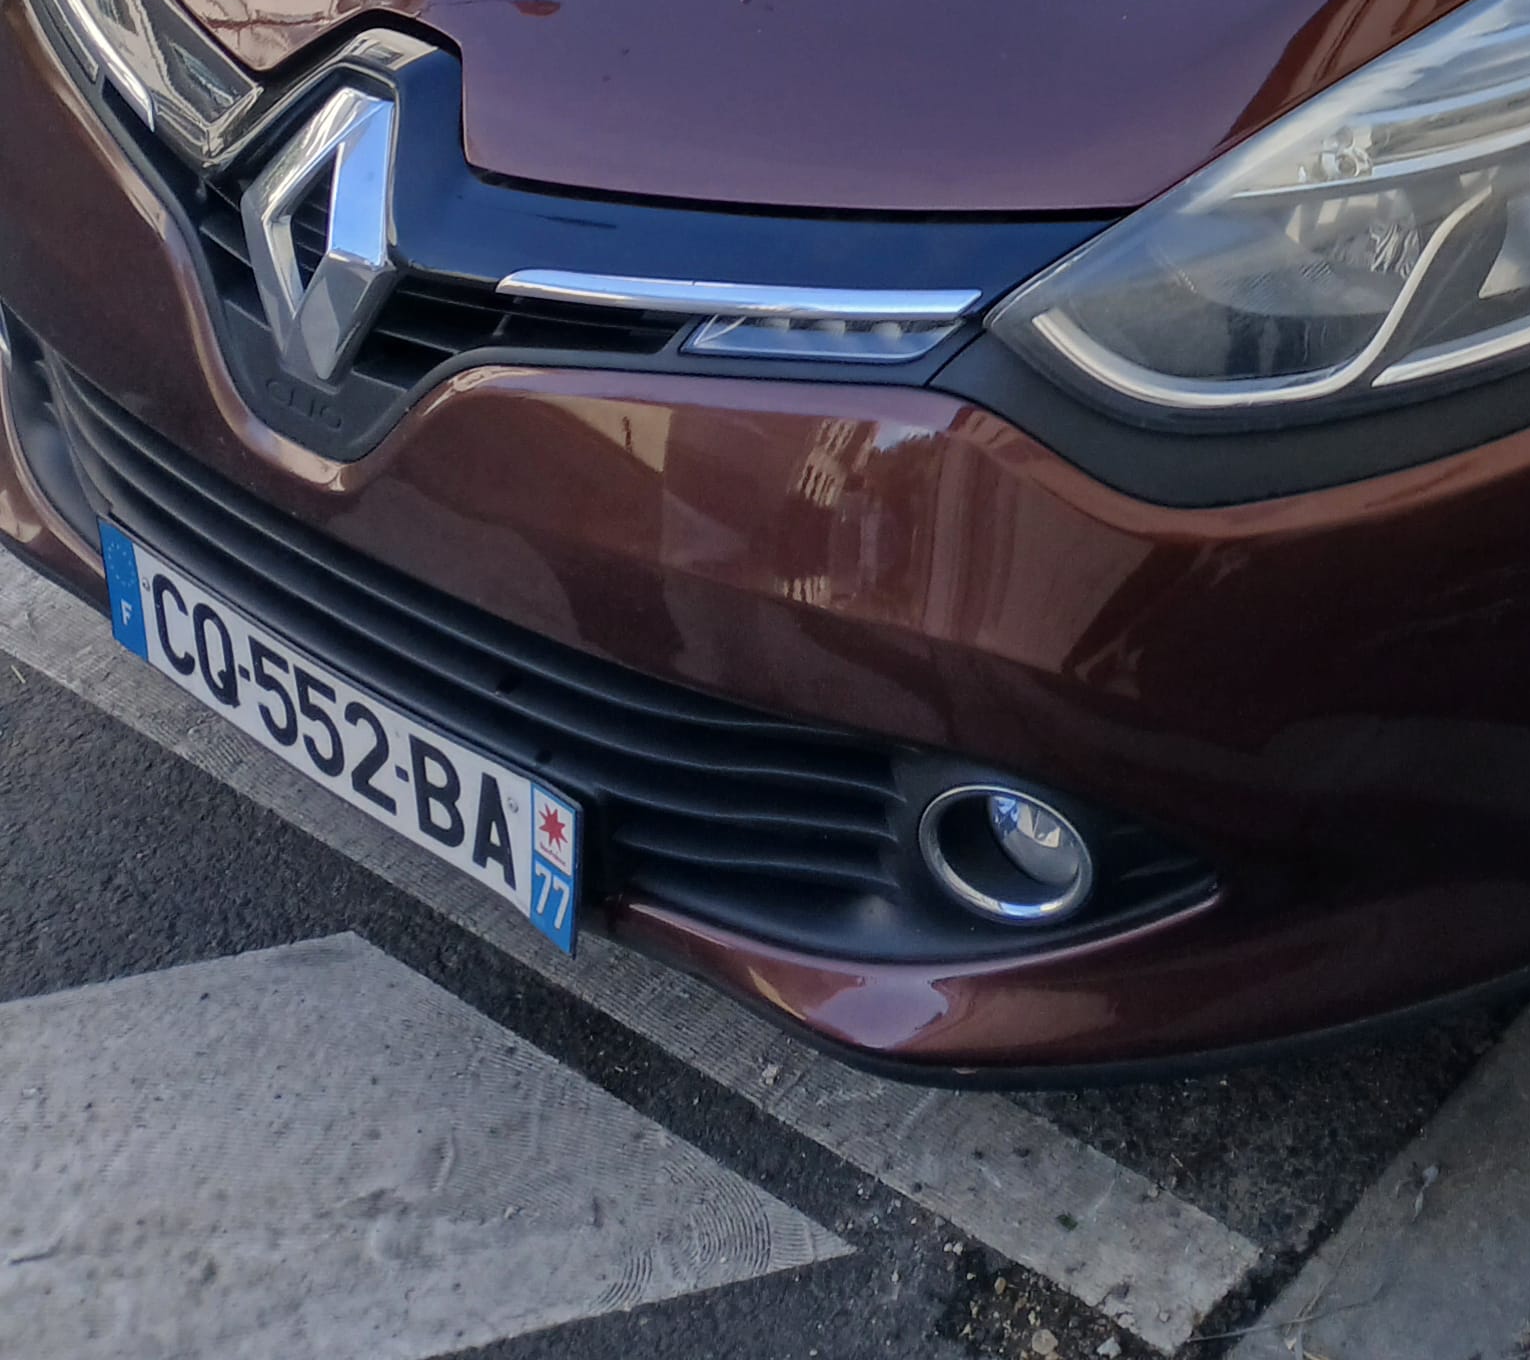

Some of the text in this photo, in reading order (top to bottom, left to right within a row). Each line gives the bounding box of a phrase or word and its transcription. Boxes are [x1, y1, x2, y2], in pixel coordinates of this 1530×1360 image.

[120, 599, 132, 626] F
[152, 573, 517, 891] CQ-552-BA
[534, 862, 571, 930] 77
